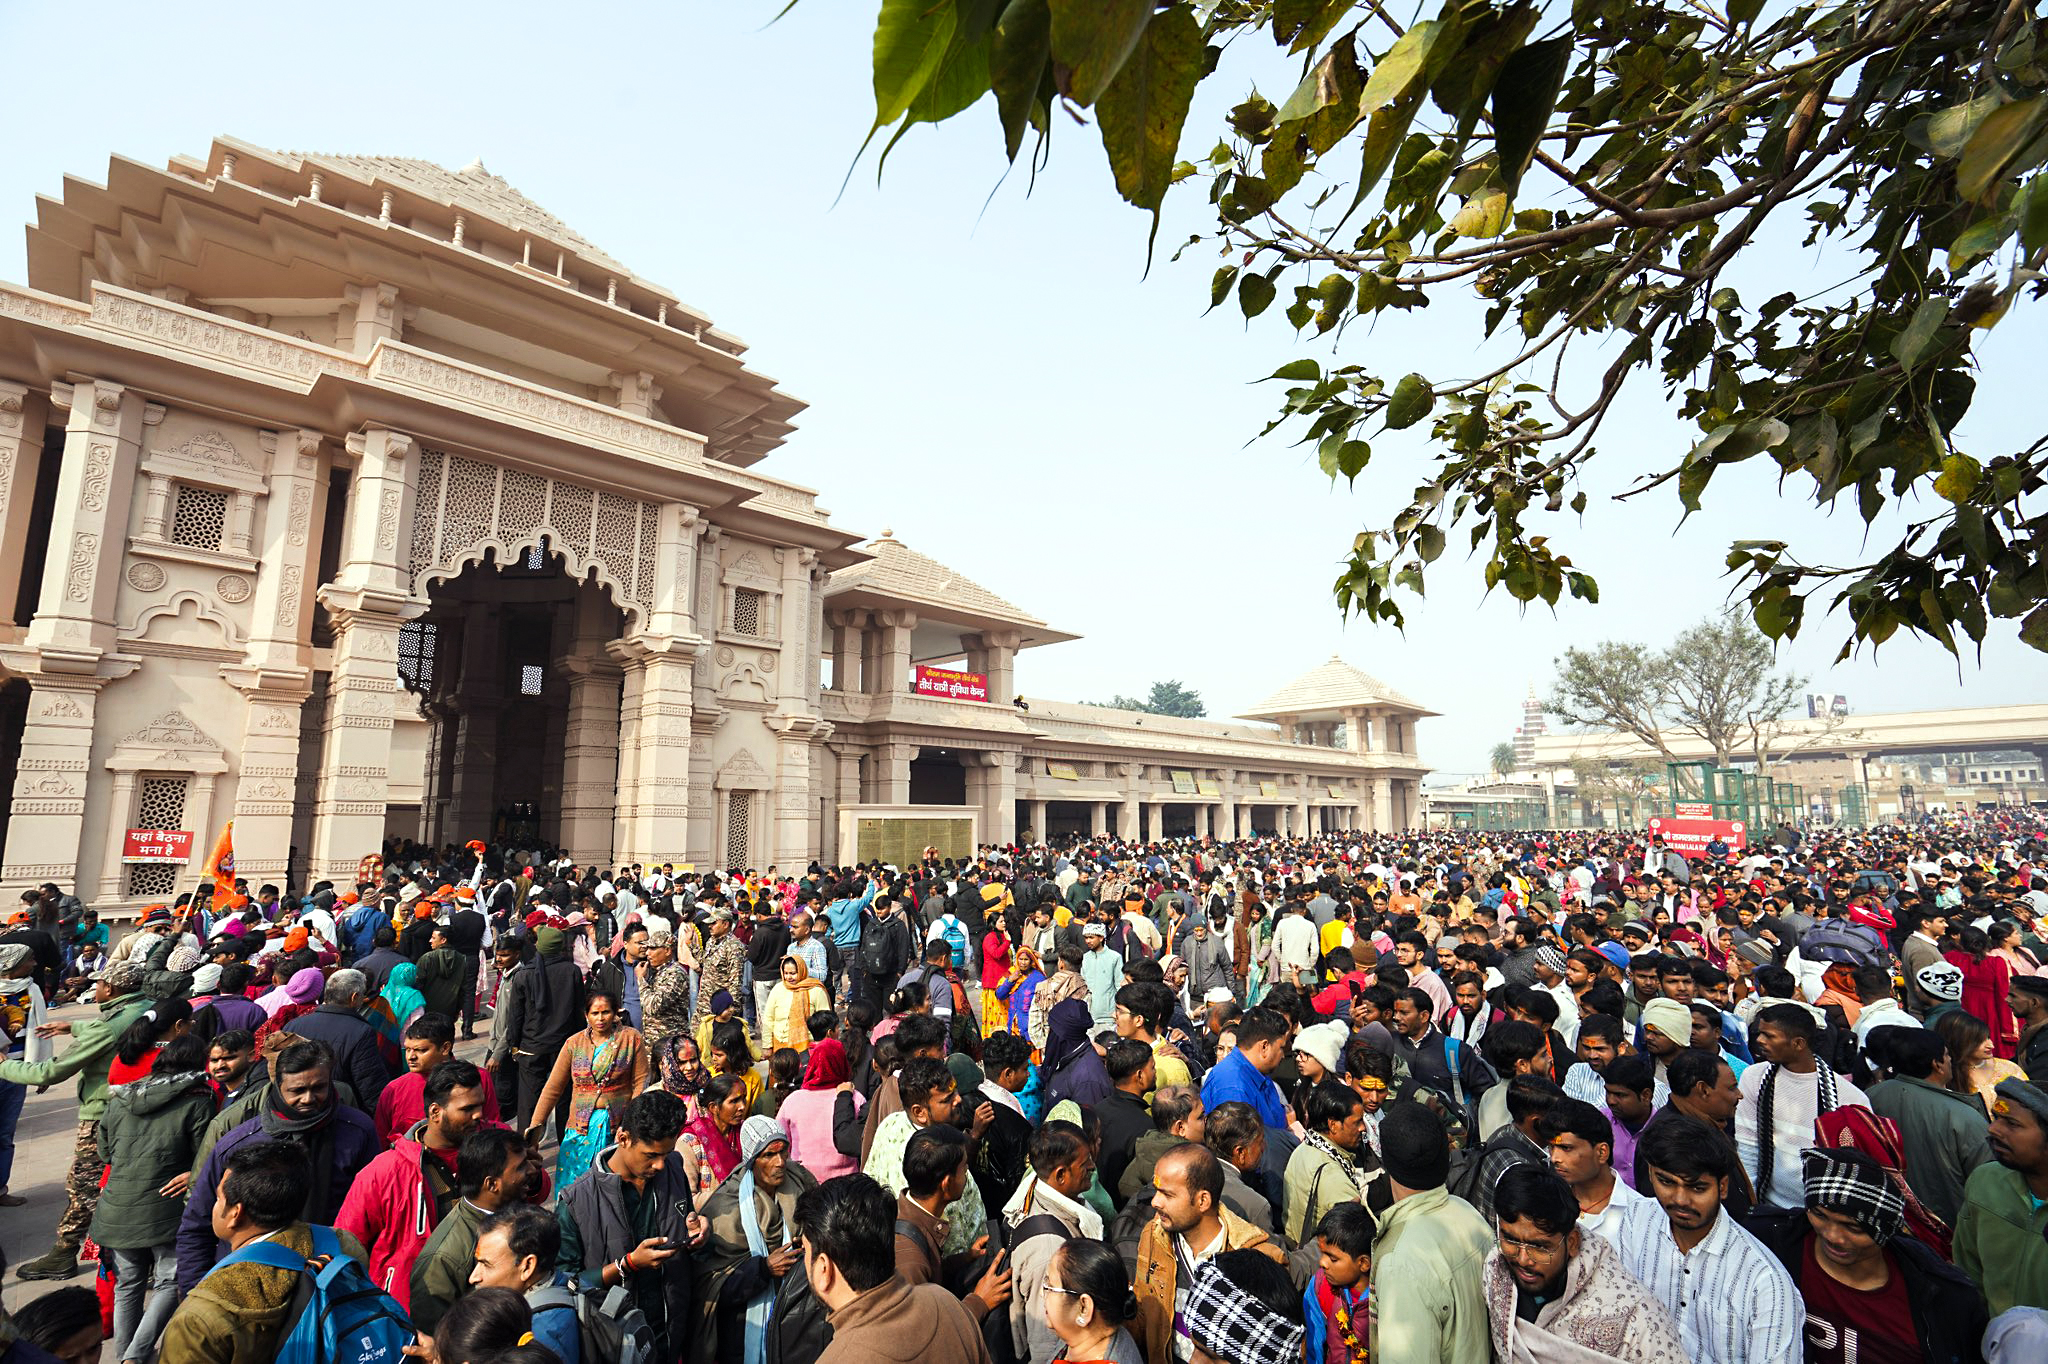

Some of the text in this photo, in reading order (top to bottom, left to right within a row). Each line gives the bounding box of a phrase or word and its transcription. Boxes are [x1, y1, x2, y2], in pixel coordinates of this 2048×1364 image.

[919, 678, 985, 698] तीर्थ यात्री सुविधा केन्द्र
[132, 831, 187, 843] यहां बैठना
[140, 844, 174, 856] मना है
